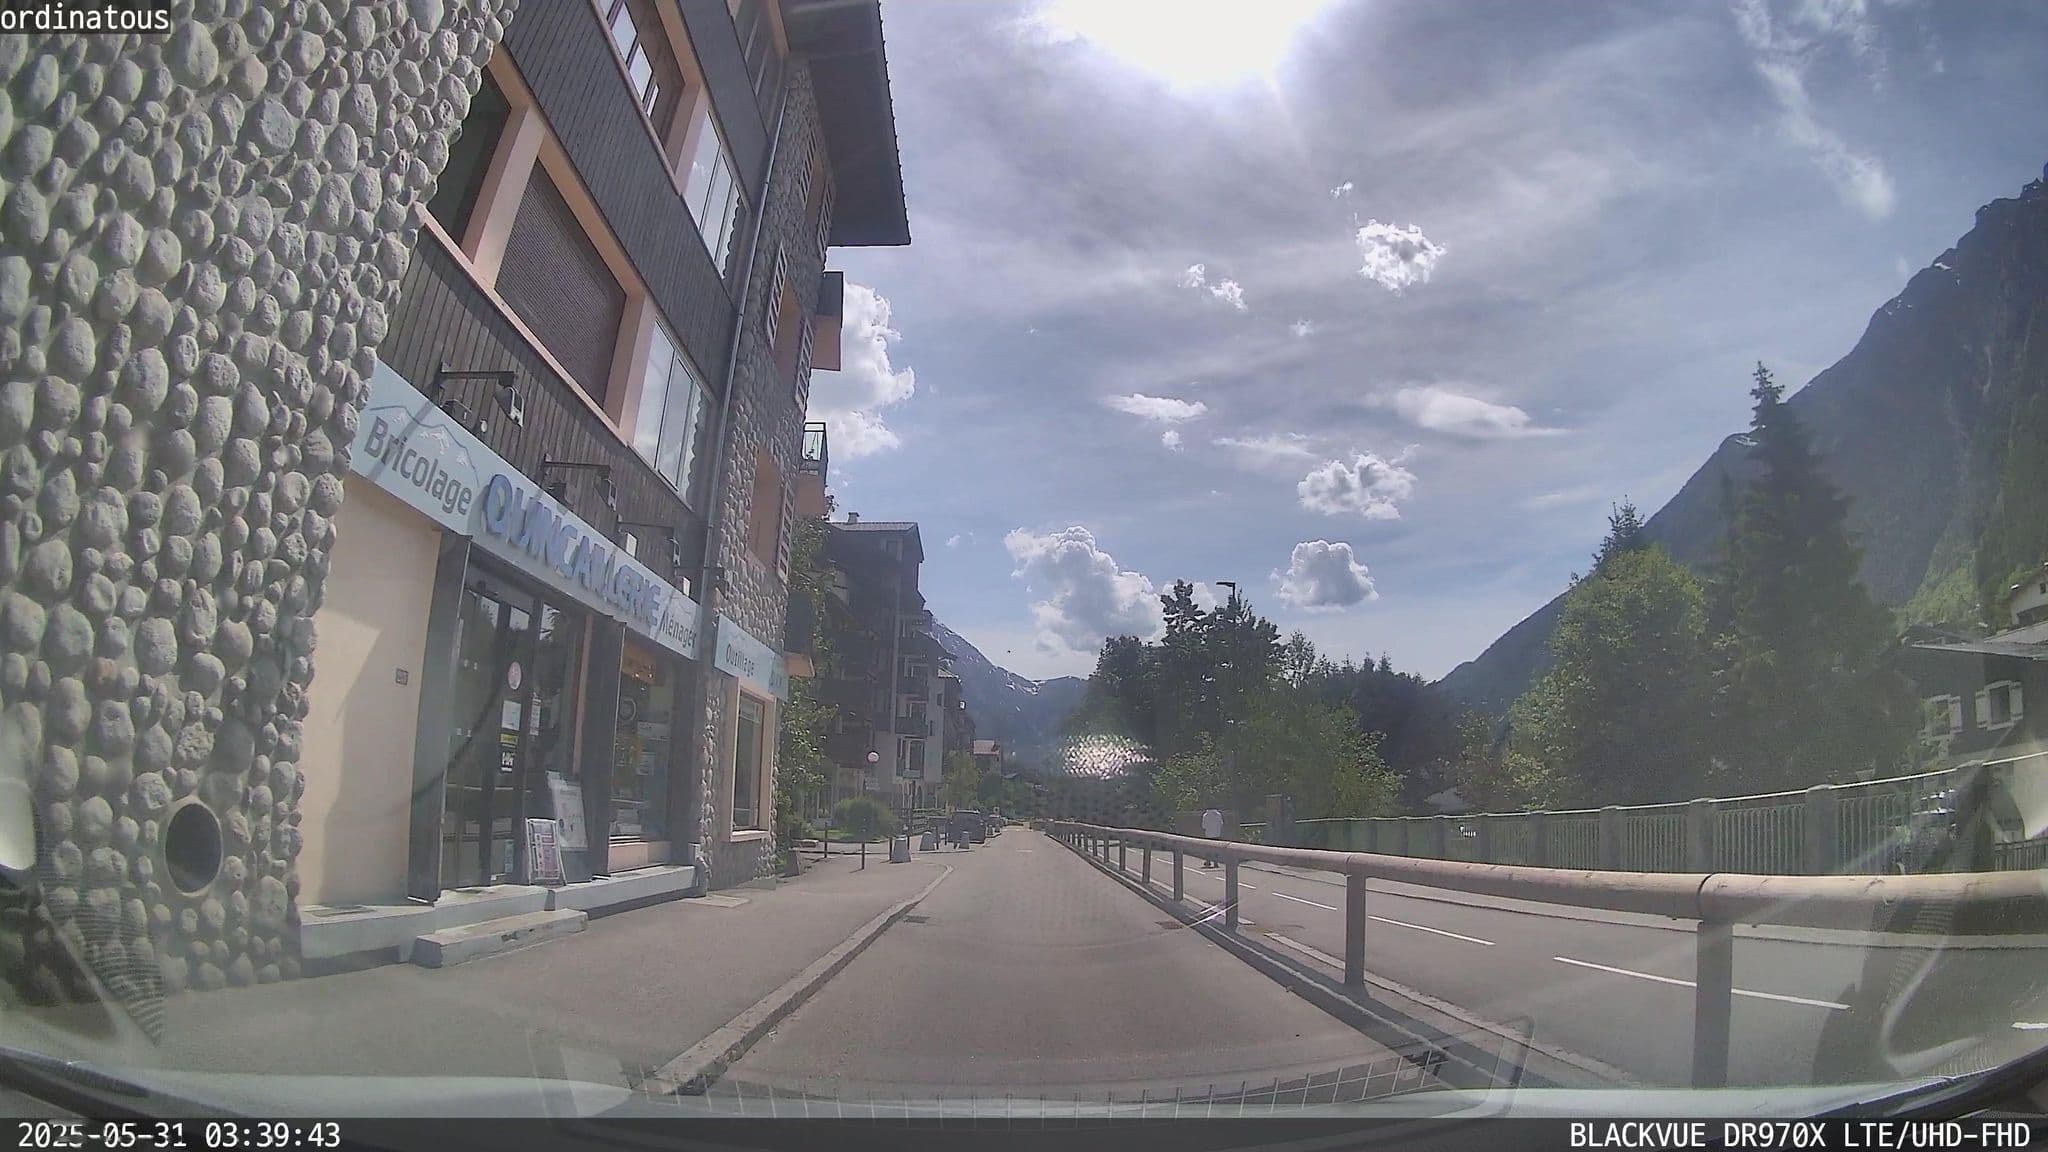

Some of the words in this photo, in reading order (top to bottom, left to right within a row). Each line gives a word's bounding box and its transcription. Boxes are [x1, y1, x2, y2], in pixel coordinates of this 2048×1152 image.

[364, 416, 472, 515] Bricolage
[486, 474, 661, 627] QUINCAILLERIE
[726, 643, 755, 677] Outillage
